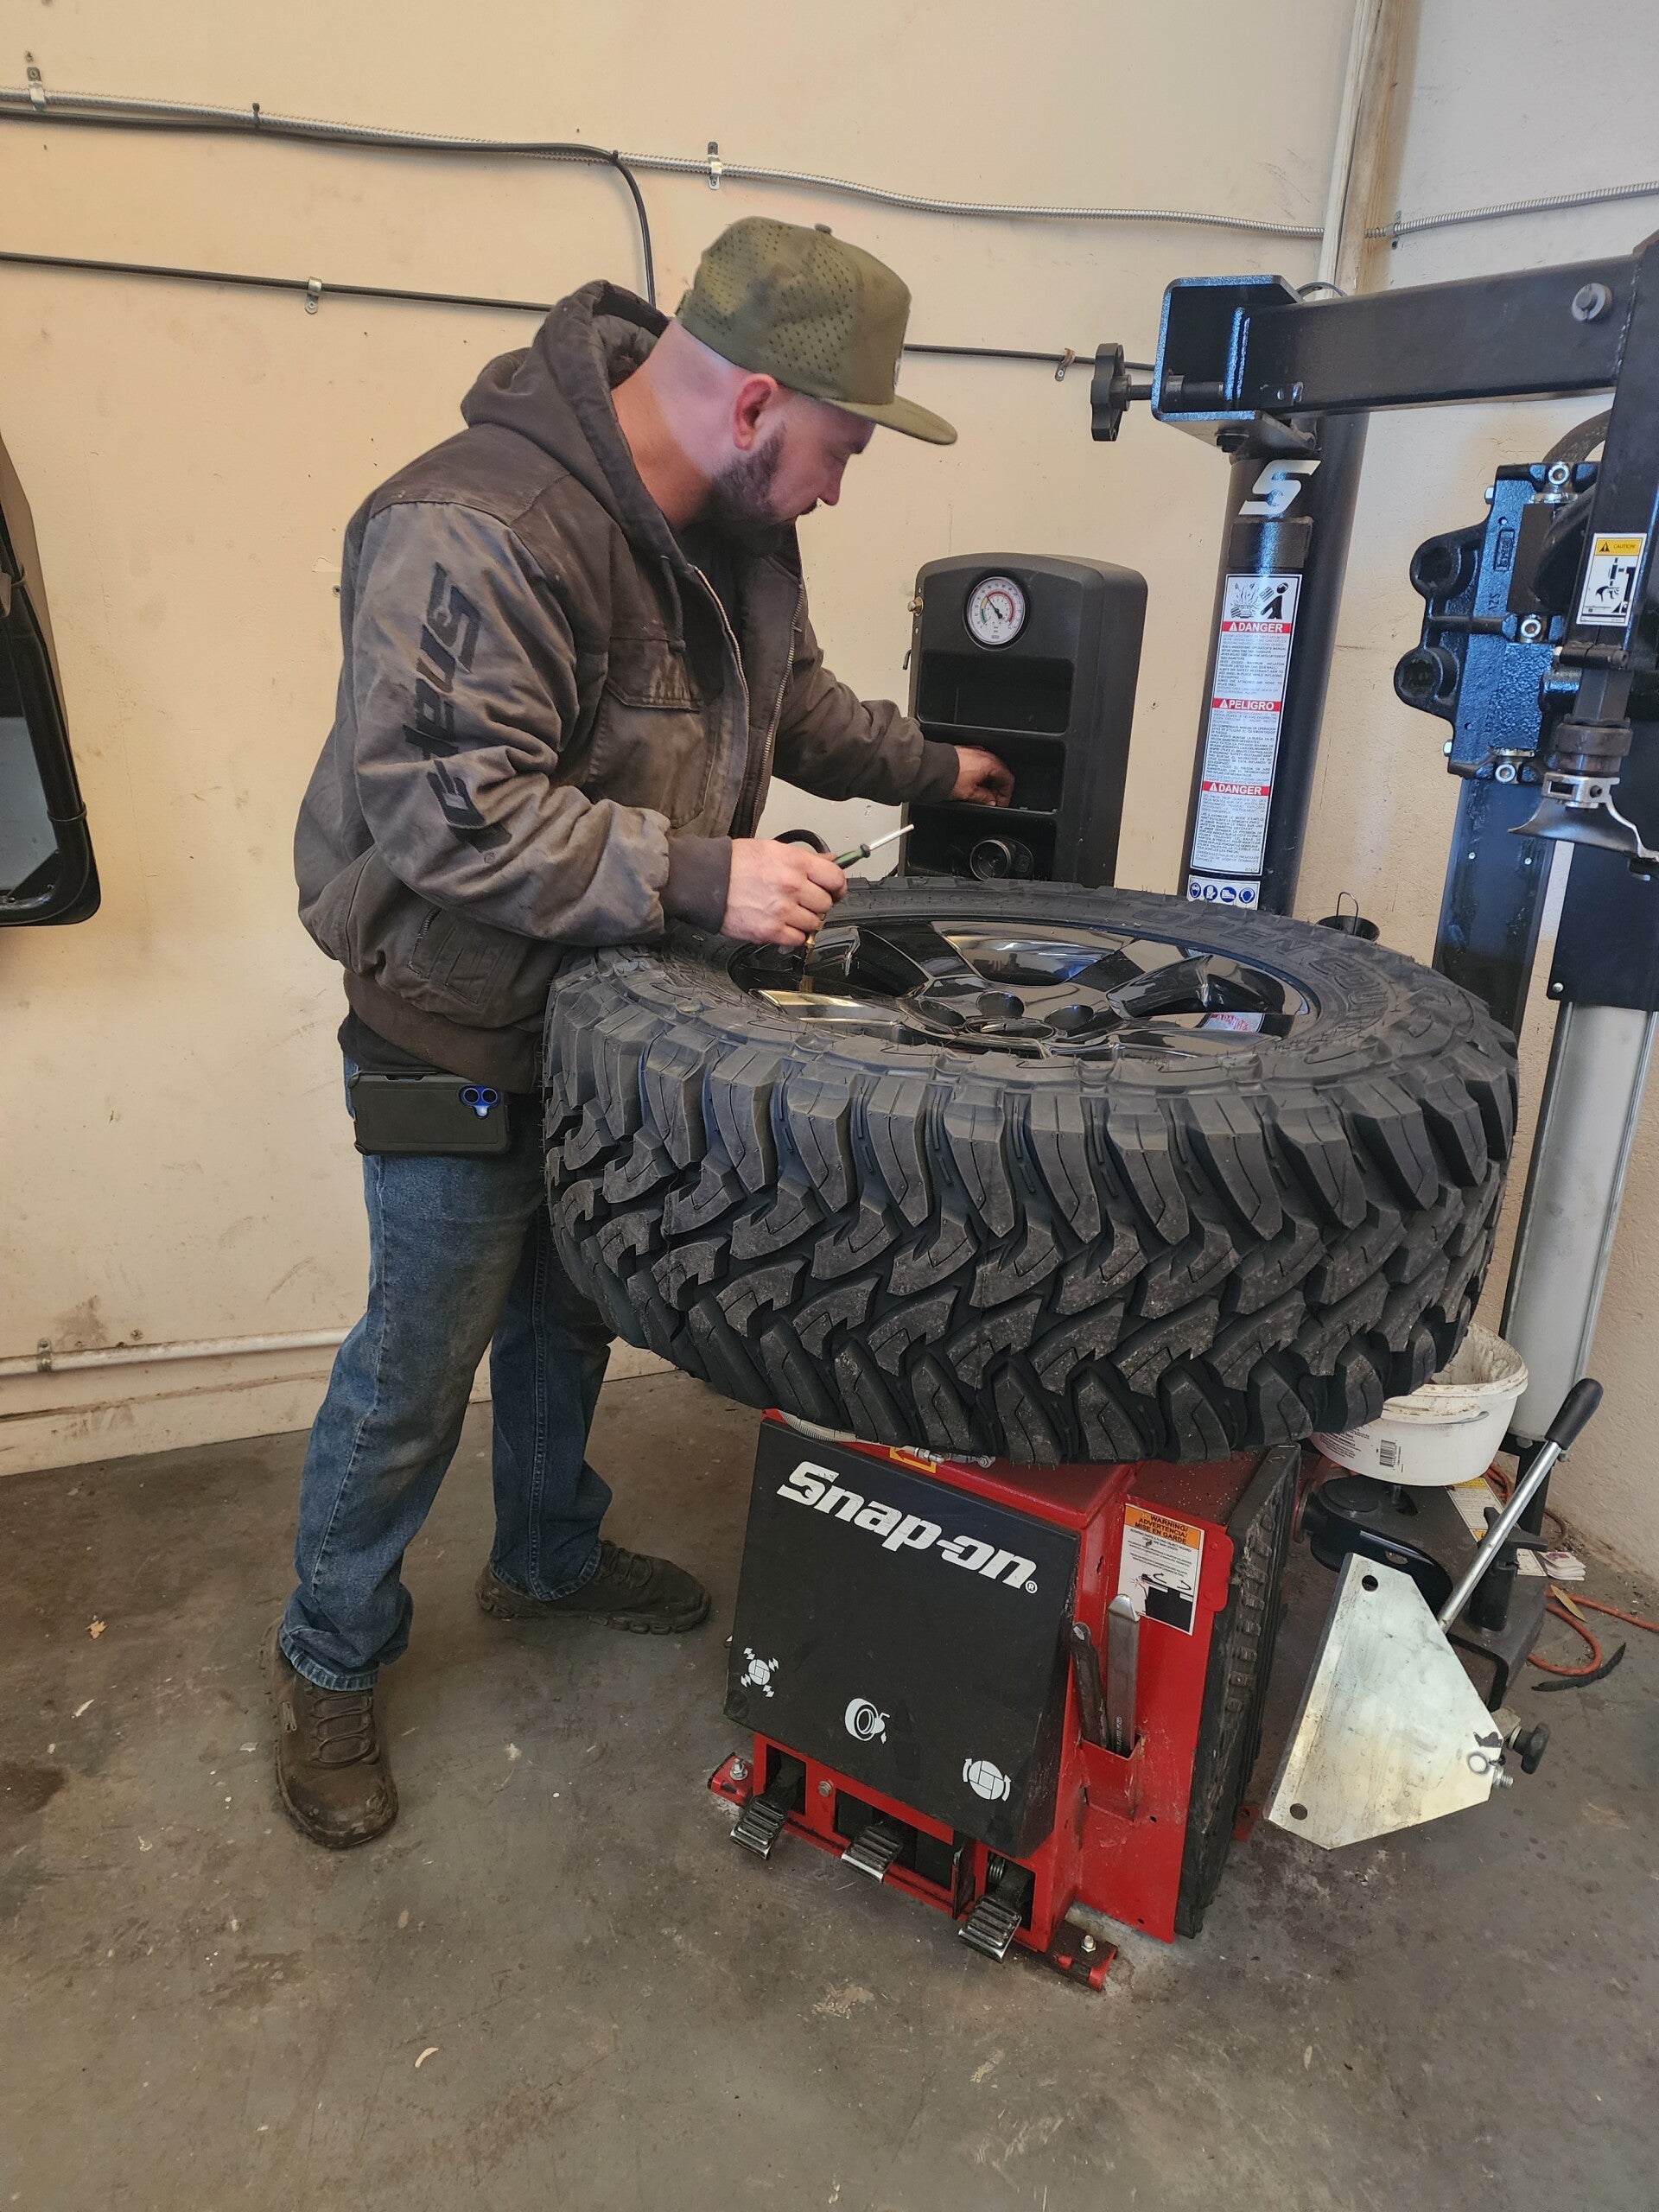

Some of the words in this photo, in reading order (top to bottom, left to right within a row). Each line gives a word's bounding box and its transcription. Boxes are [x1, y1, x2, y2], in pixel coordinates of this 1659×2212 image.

[1239, 622, 1283, 632] DANGER
[1229, 700, 1274, 710] PELIGRO
[1219, 785, 1262, 795] DANGER
[1139, 1518, 1188, 1538] ADVERTENCIA/
[1151, 1515, 1188, 1533] WARNING/
[1135, 1522, 1151, 1532] MISE
[1163, 1532, 1187, 1544] GARDE
